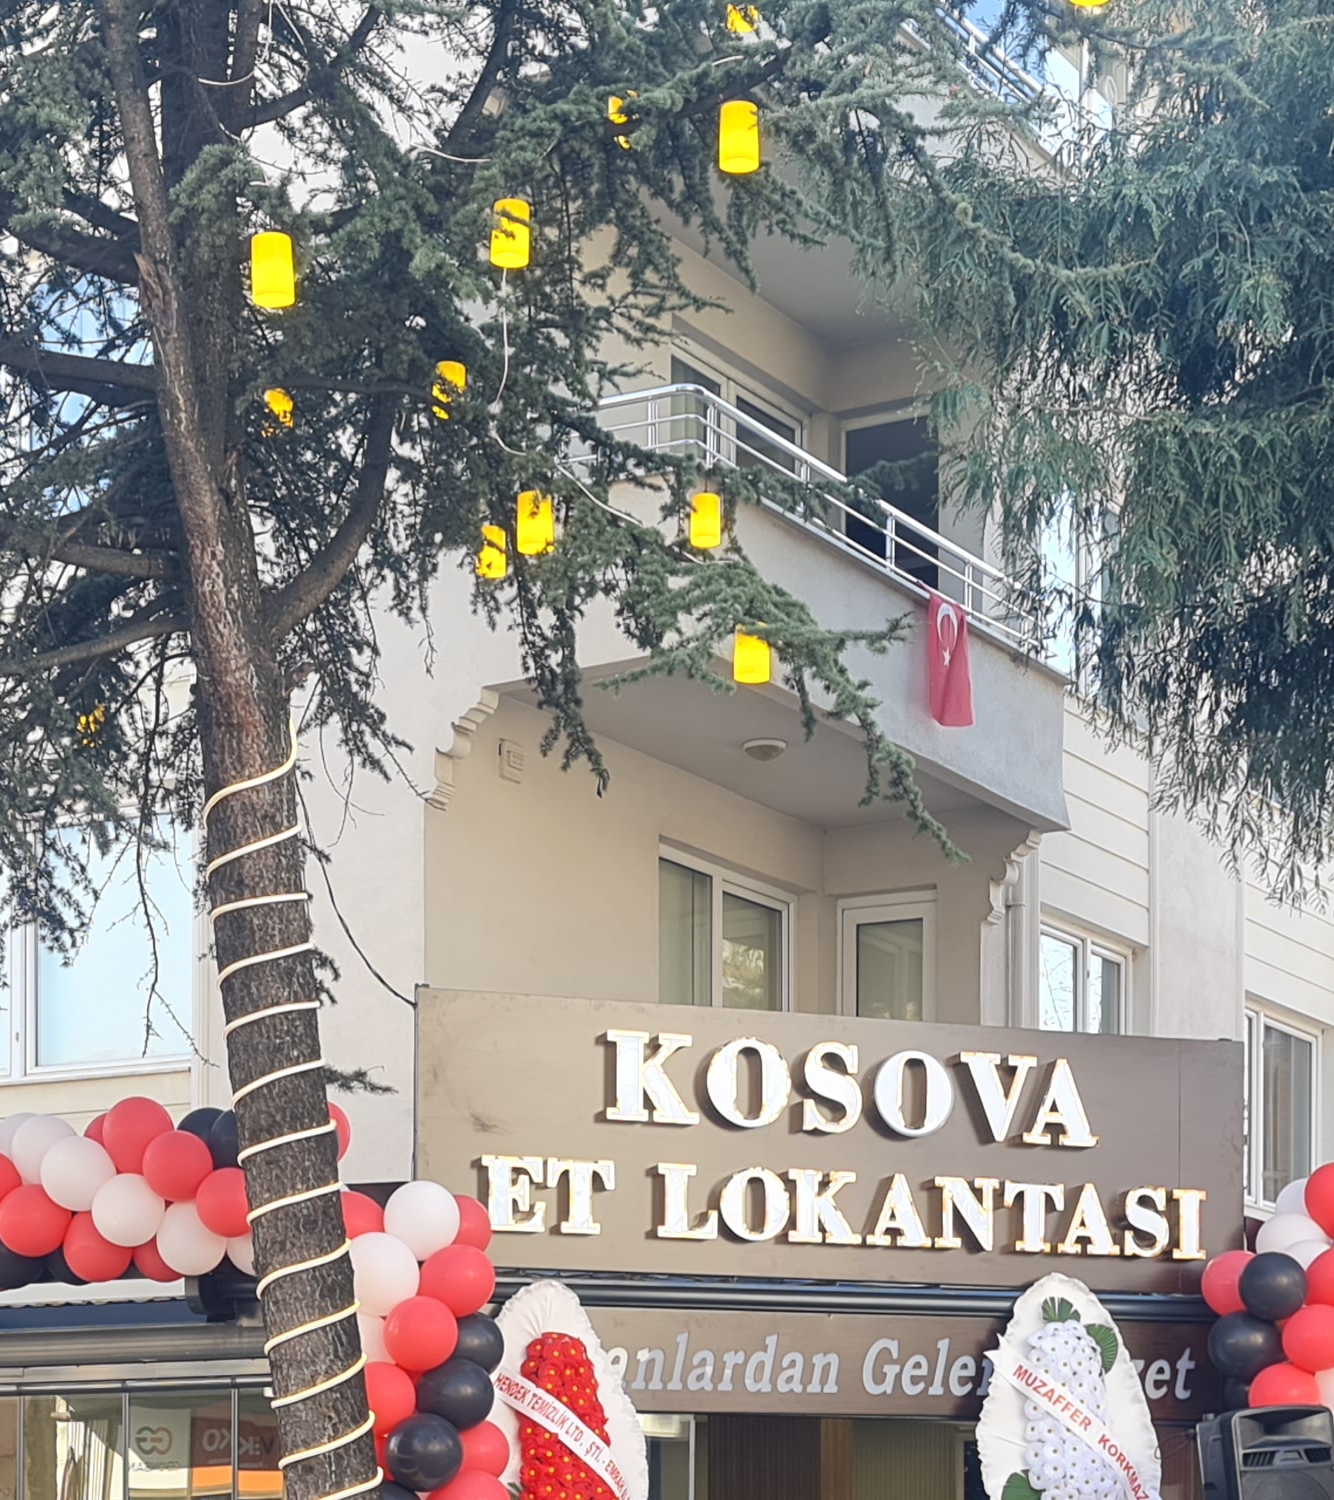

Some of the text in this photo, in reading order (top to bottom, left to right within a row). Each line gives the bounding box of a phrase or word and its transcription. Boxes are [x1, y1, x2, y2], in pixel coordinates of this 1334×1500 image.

[603, 1029, 1100, 1148] KOSOVA
[481, 1155, 1207, 1261] ET LOKANTASI
[607, 1330, 840, 1395] anlardan
[494, 1373, 531, 1404] HENDEK
[527, 1393, 571, 1431] TEMİZLİK
[1012, 1364, 1092, 1432] MUZAFFER
